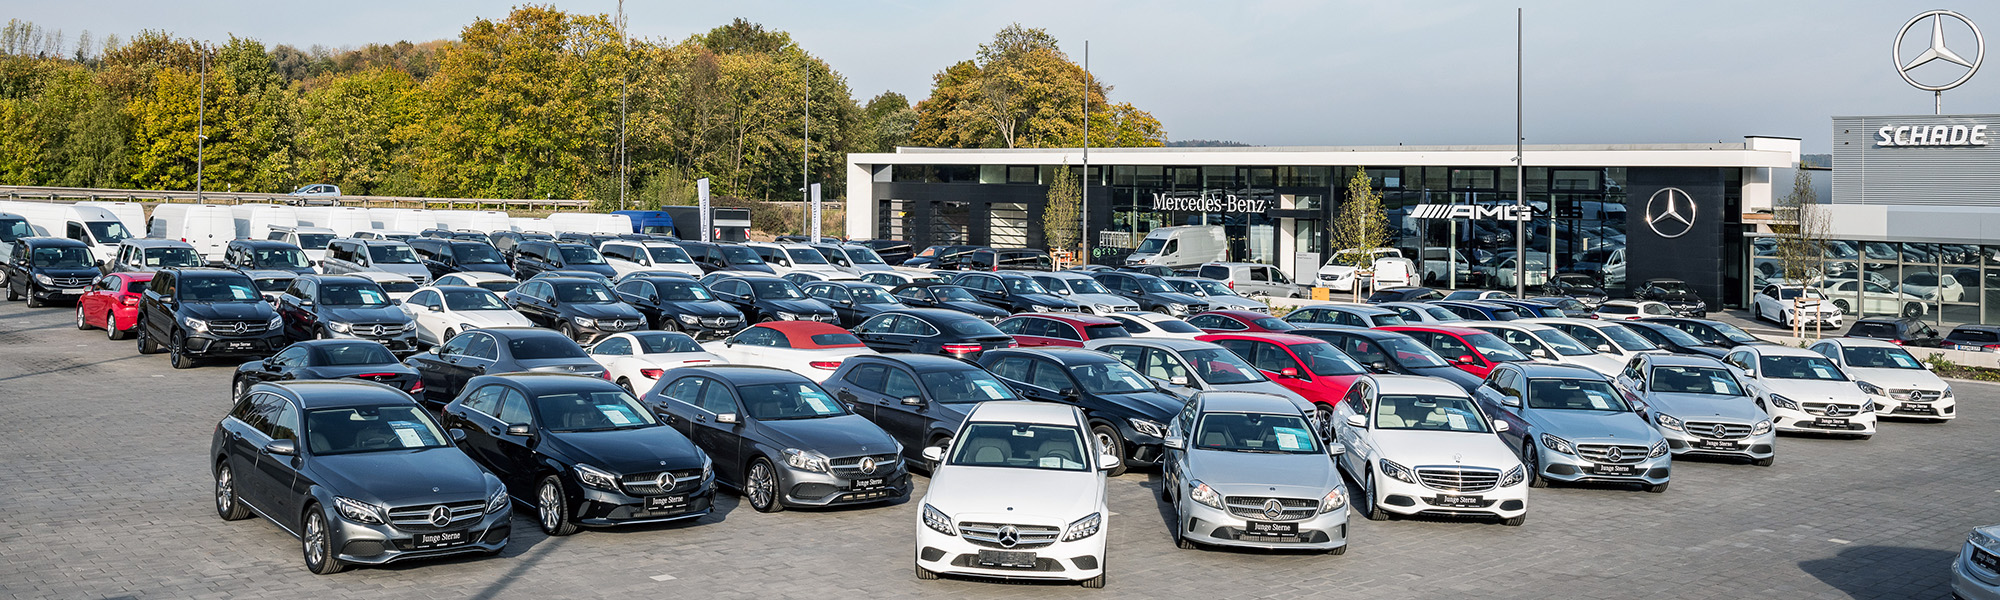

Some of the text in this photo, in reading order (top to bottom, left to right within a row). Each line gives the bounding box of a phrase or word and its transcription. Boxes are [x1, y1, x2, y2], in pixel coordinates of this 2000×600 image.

[1877, 125, 1988, 146] SCHADE
[1152, 193, 1265, 213] Mercedes-Benz
[652, 496, 684, 505] Junge Sterne
[1444, 495, 1477, 504] Junge Sterne
[1254, 523, 1290, 531] Junge Sterne
[422, 532, 460, 543] Junge Sterne
